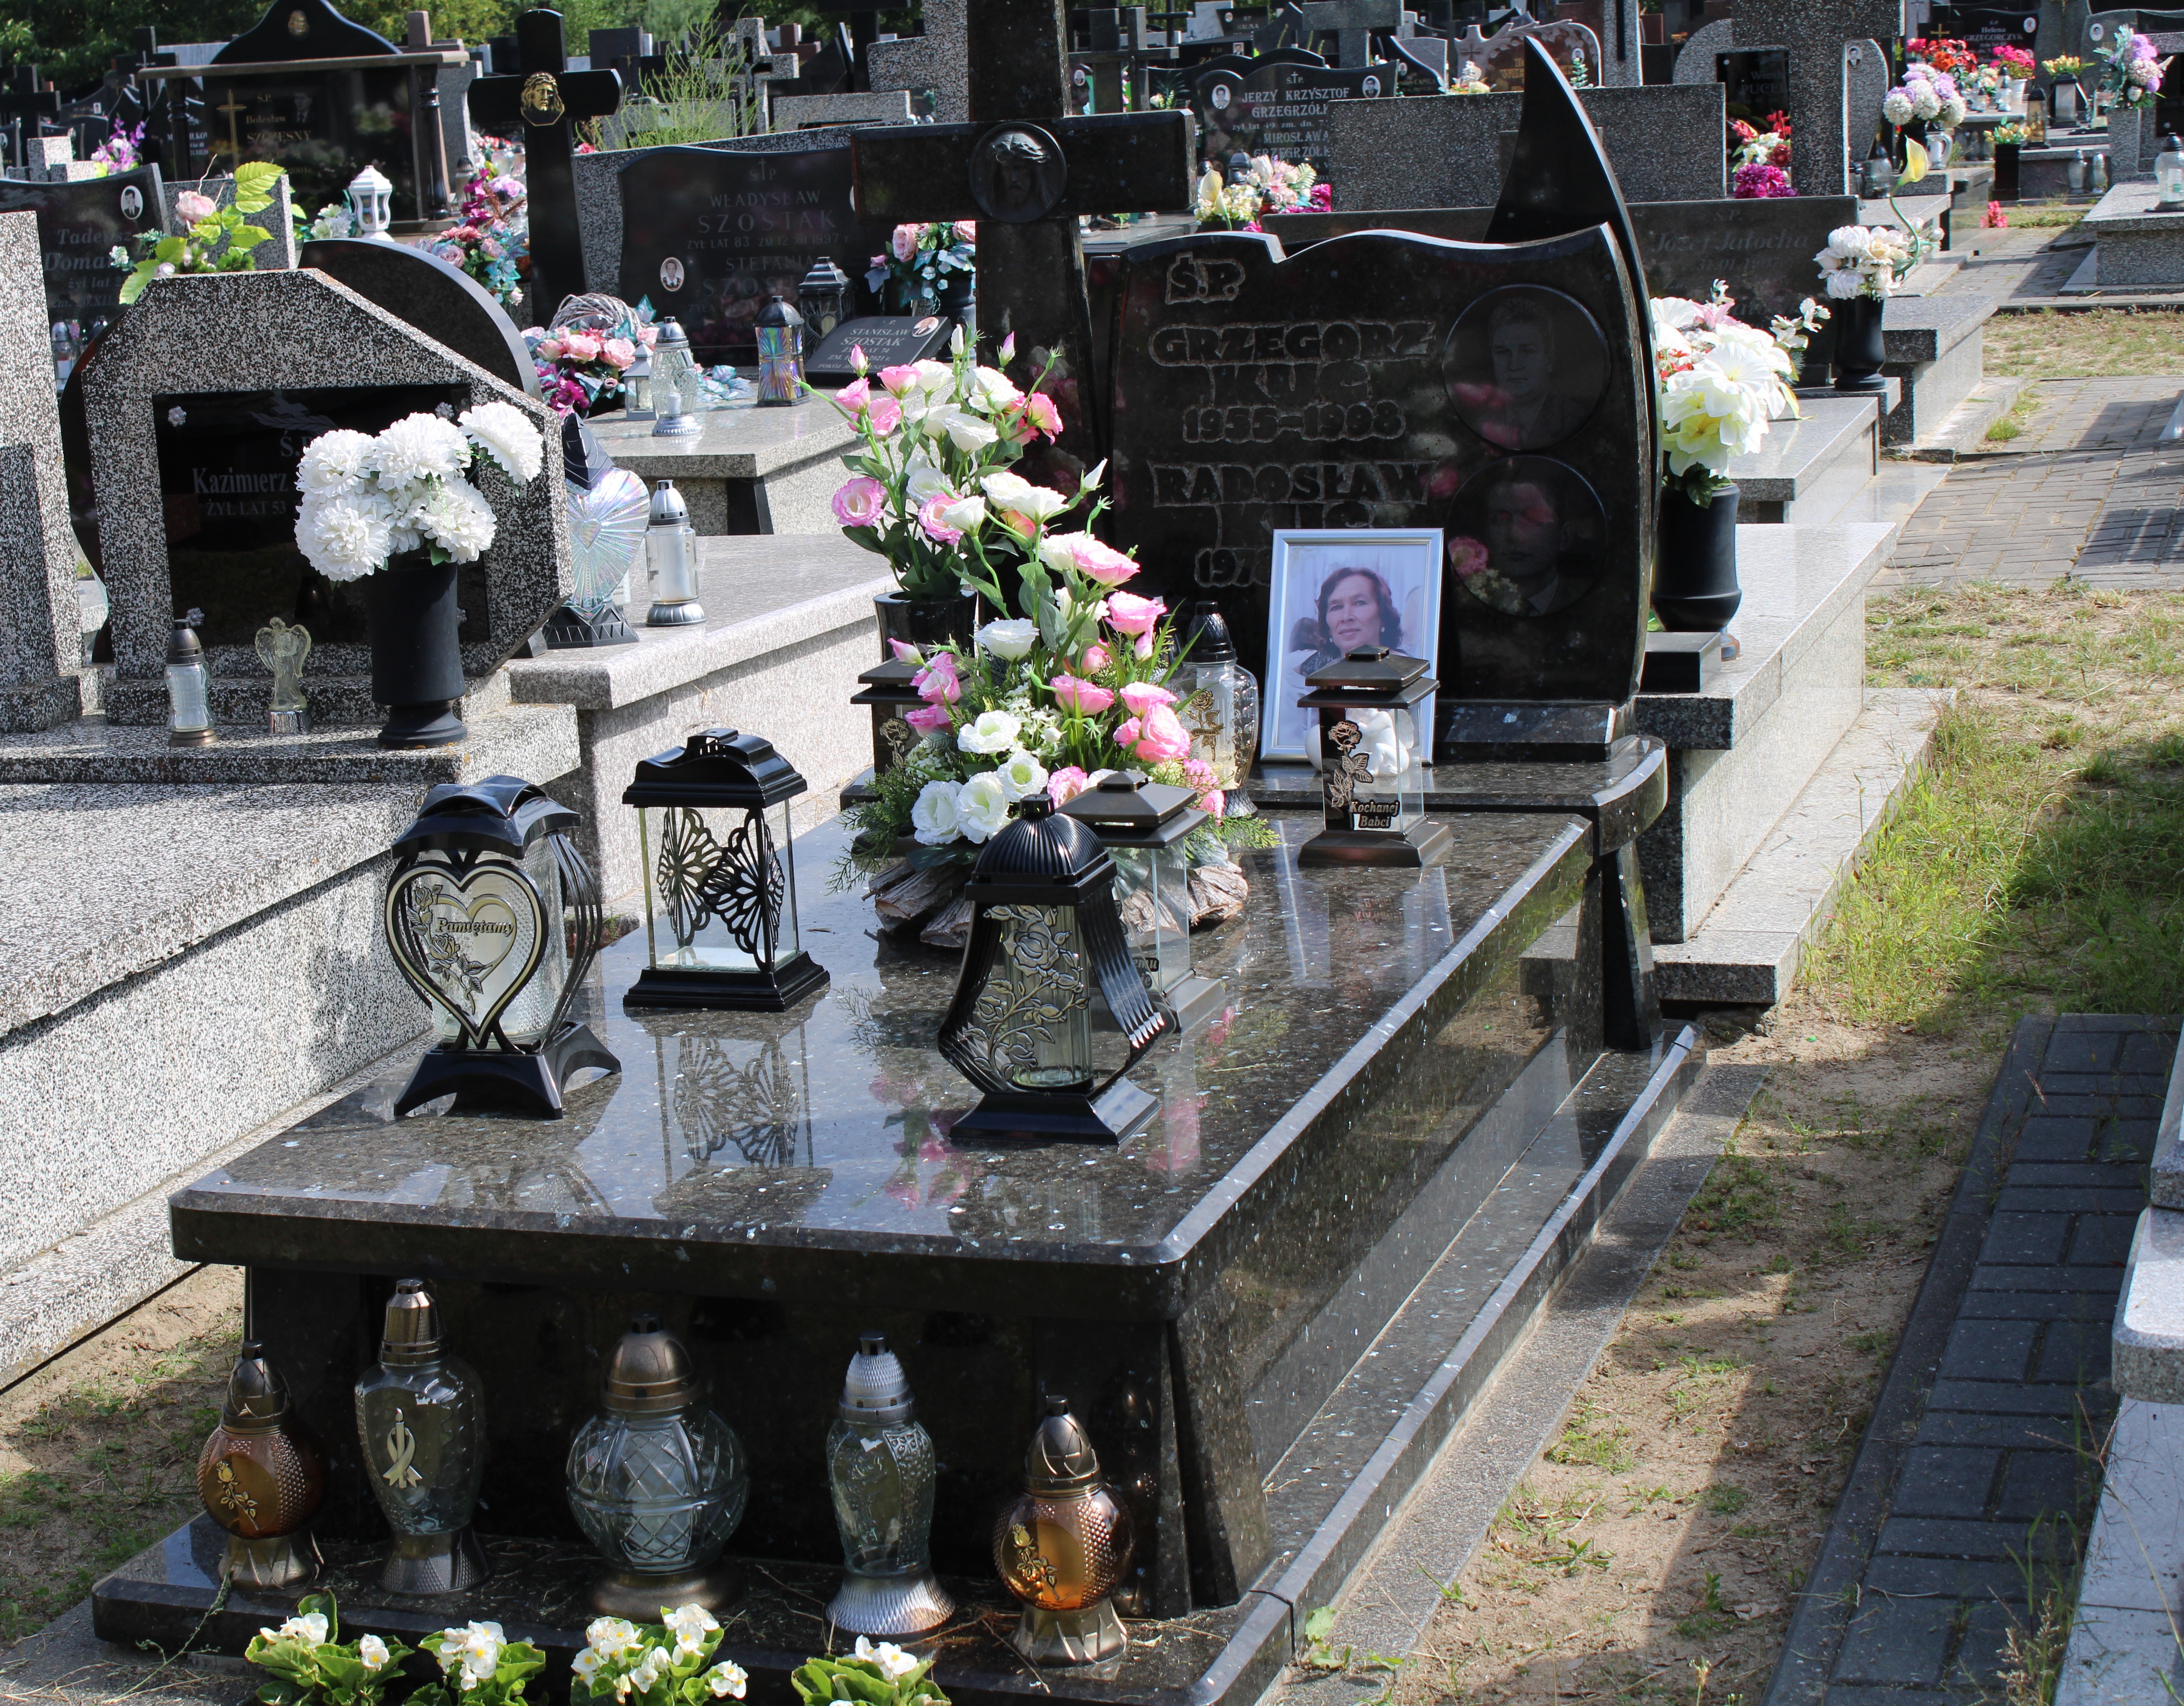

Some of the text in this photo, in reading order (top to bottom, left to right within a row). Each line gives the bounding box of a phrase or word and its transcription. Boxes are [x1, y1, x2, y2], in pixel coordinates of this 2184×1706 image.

[1242, 87, 1350, 103] JERZY KRZYSZTOF
[246, 115, 286, 124] Bolesław
[247, 130, 311, 144] SZCZĘSNY
[710, 190, 820, 208] WŁADYSŁAW
[698, 209, 836, 233] SZOSTAK
[58, 227, 132, 244] Tadeusz
[711, 239, 728, 248] LAT
[735, 237, 749, 247] 83
[1715, 229, 1809, 250] Jałocha
[726, 255, 814, 272] STEFANIA
[1165, 252, 1246, 304] Ś.P.
[841, 337, 905, 346] SZOSTAK
[1148, 319, 1436, 366] GRZEGORZ
[1206, 363, 1372, 405] KUC
[1182, 399, 1406, 443] 1955-1998
[192, 467, 288, 494] Kazimierz
[1147, 459, 1438, 508] RADOSŁAW
[240, 501, 268, 516] LAT
[272, 500, 286, 514] 53
[1349, 801, 1399, 816] Kochanej
[1361, 816, 1390, 827] Babci
[436, 917, 514, 937] Pamiętamy
